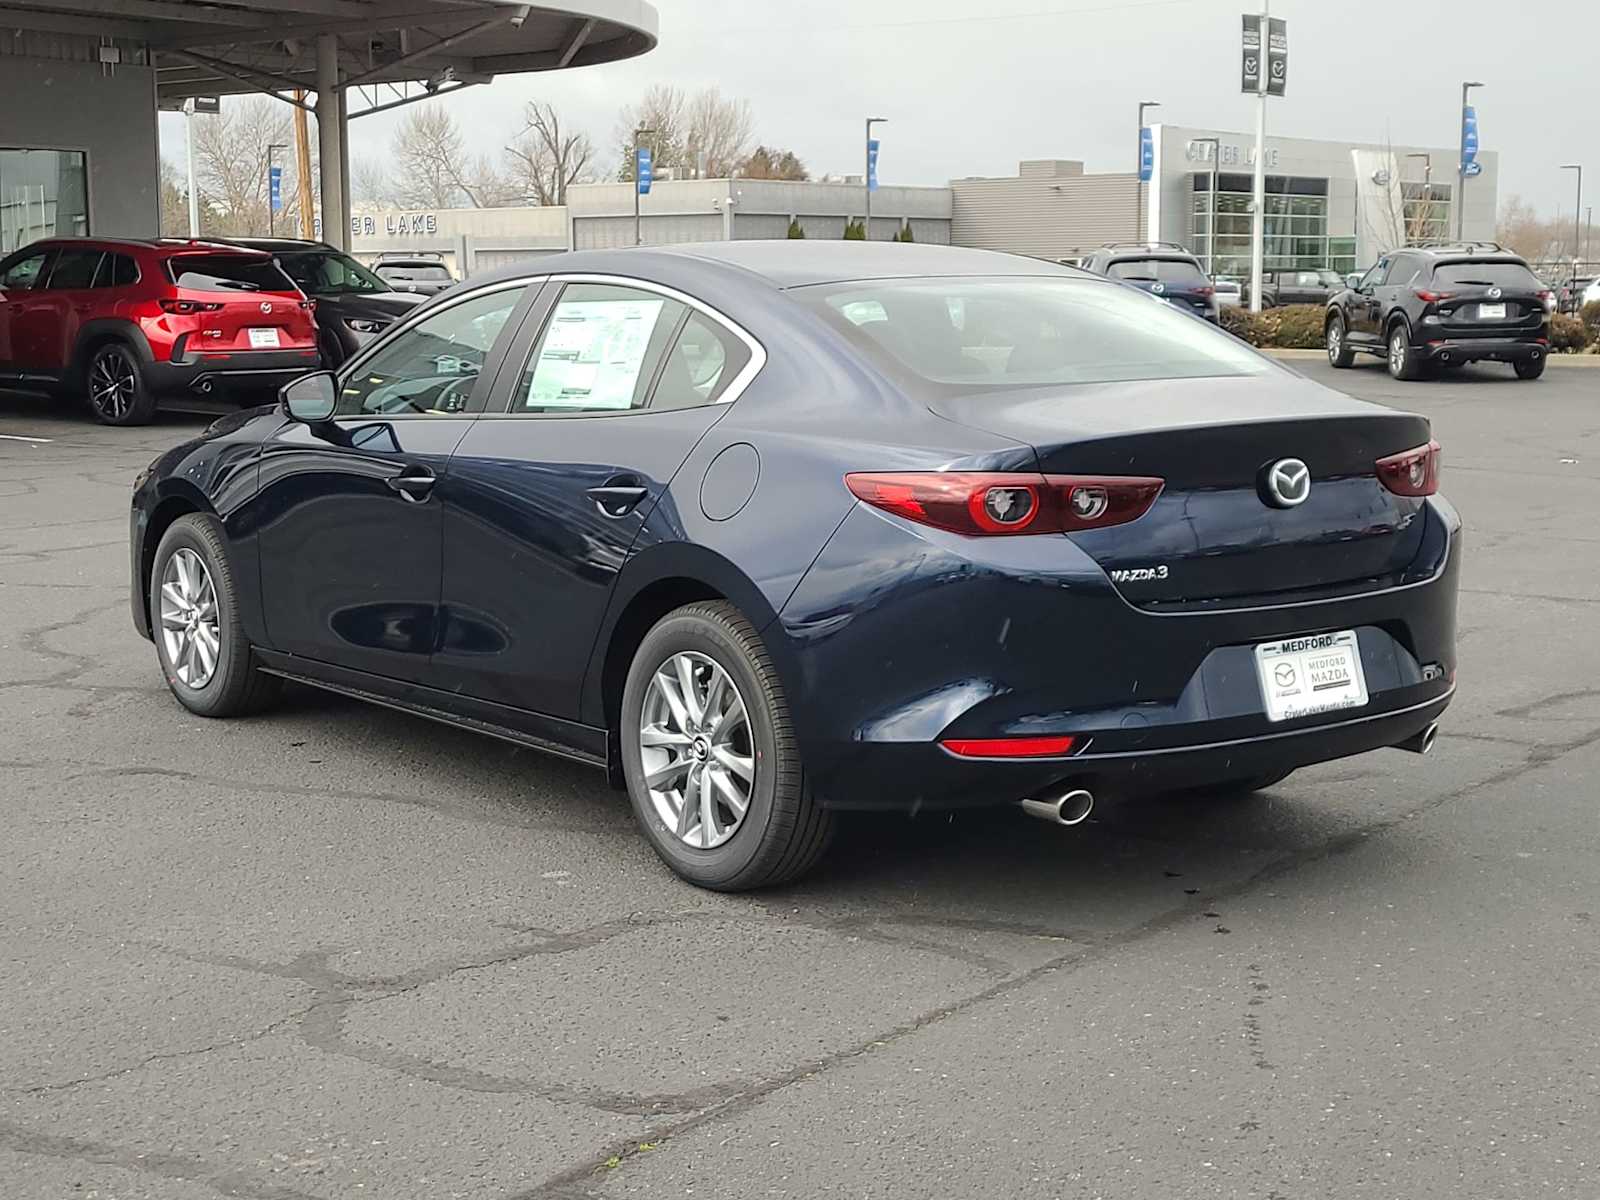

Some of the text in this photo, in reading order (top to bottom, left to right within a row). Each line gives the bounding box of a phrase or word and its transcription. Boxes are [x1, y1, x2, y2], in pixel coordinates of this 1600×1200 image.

[386, 214, 437, 234] LAKE
[1282, 635, 1333, 653] MEDFORD
[1308, 656, 1346, 670] MEDFORD
[1311, 668, 1349, 683] MAZDA
